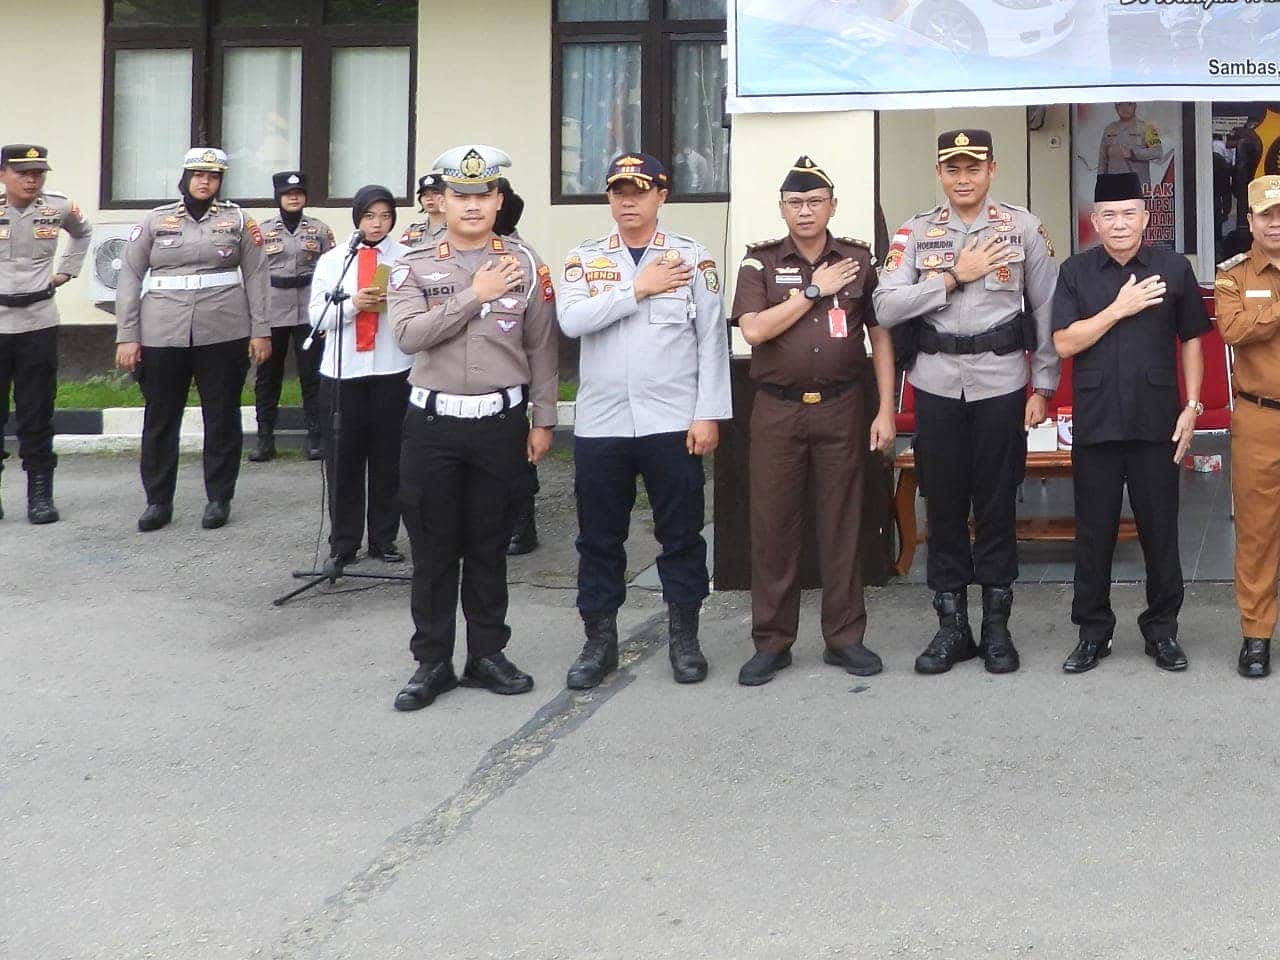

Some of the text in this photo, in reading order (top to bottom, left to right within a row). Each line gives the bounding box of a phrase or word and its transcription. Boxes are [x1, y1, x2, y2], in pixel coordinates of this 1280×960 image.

[1208, 58, 1280, 77] Sambas,
[1142, 182, 1174, 197] LAK
[586, 271, 619, 281] HENDI
